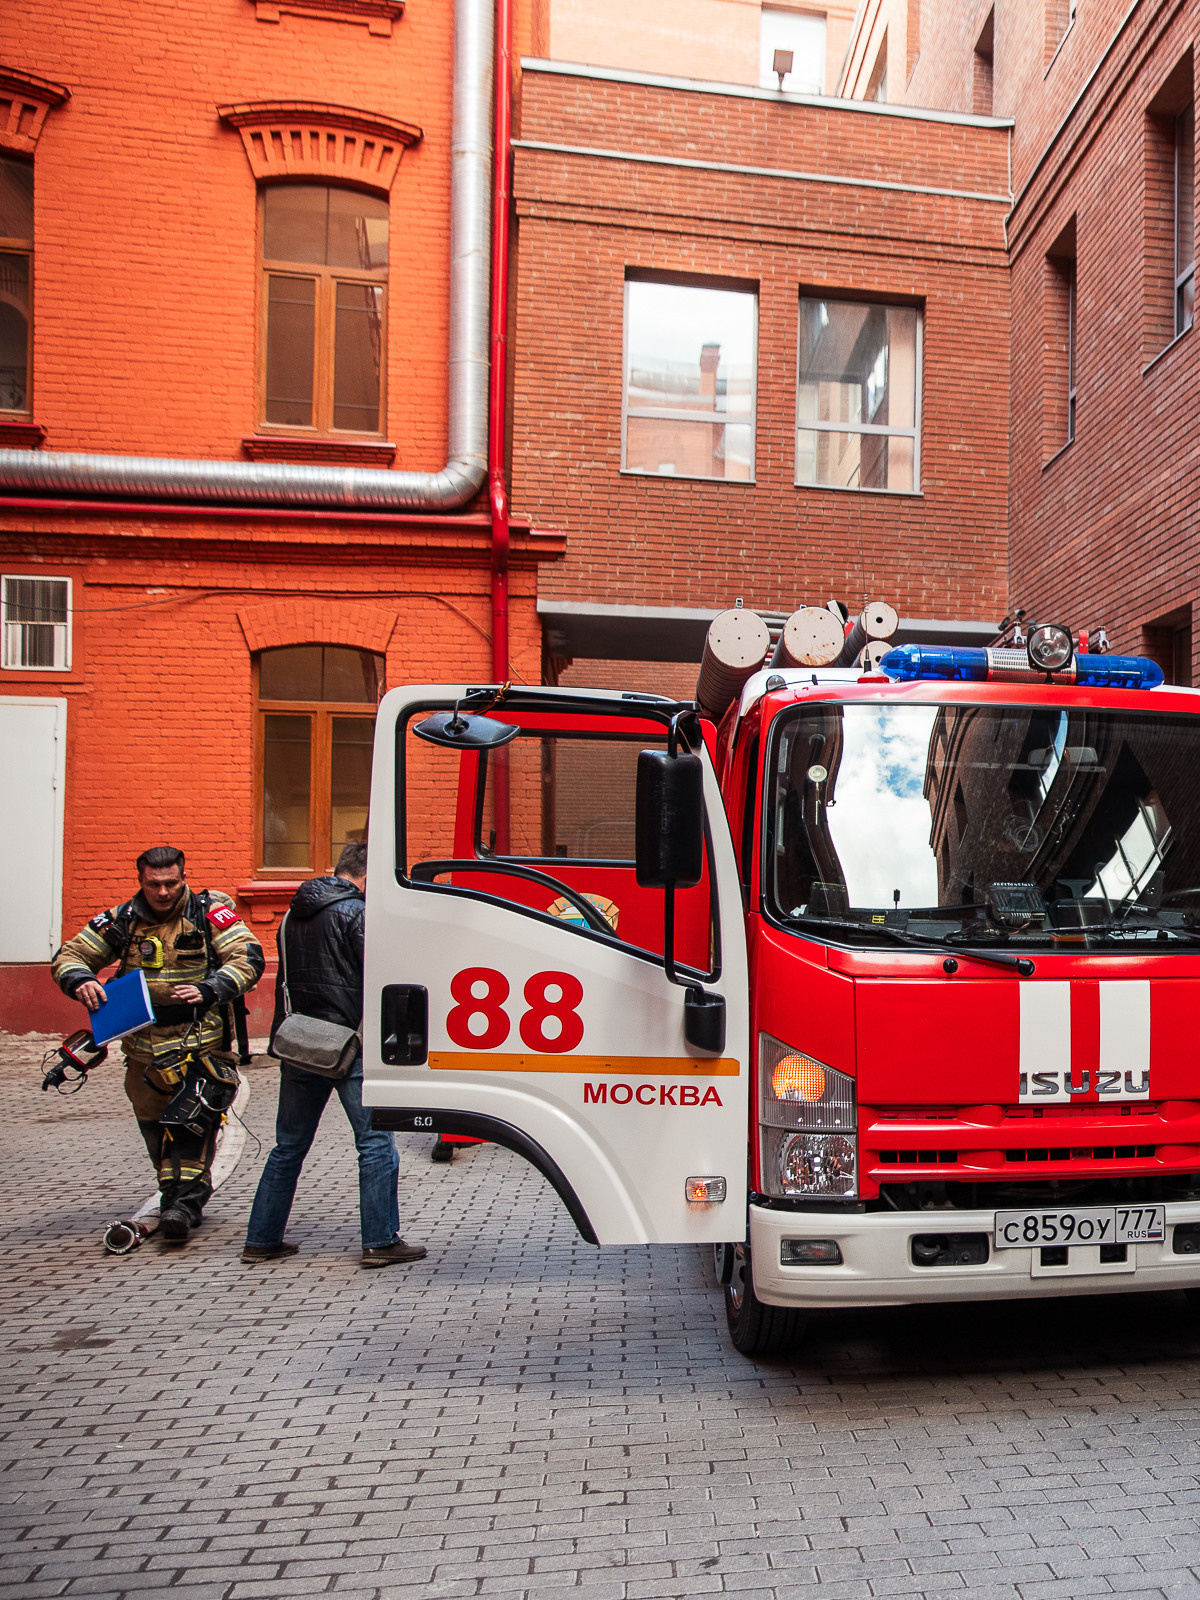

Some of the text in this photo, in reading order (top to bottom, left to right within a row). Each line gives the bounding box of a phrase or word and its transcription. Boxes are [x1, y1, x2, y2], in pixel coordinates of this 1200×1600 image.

[446, 966, 584, 1054] 88
[583, 1082, 723, 1107] МОСКВА
[1018, 1069, 1150, 1096] ISUZU
[414, 1116, 433, 1126] 6.0
[1117, 1208, 1157, 1231] 777
[1127, 1230, 1147, 1239] RUS
